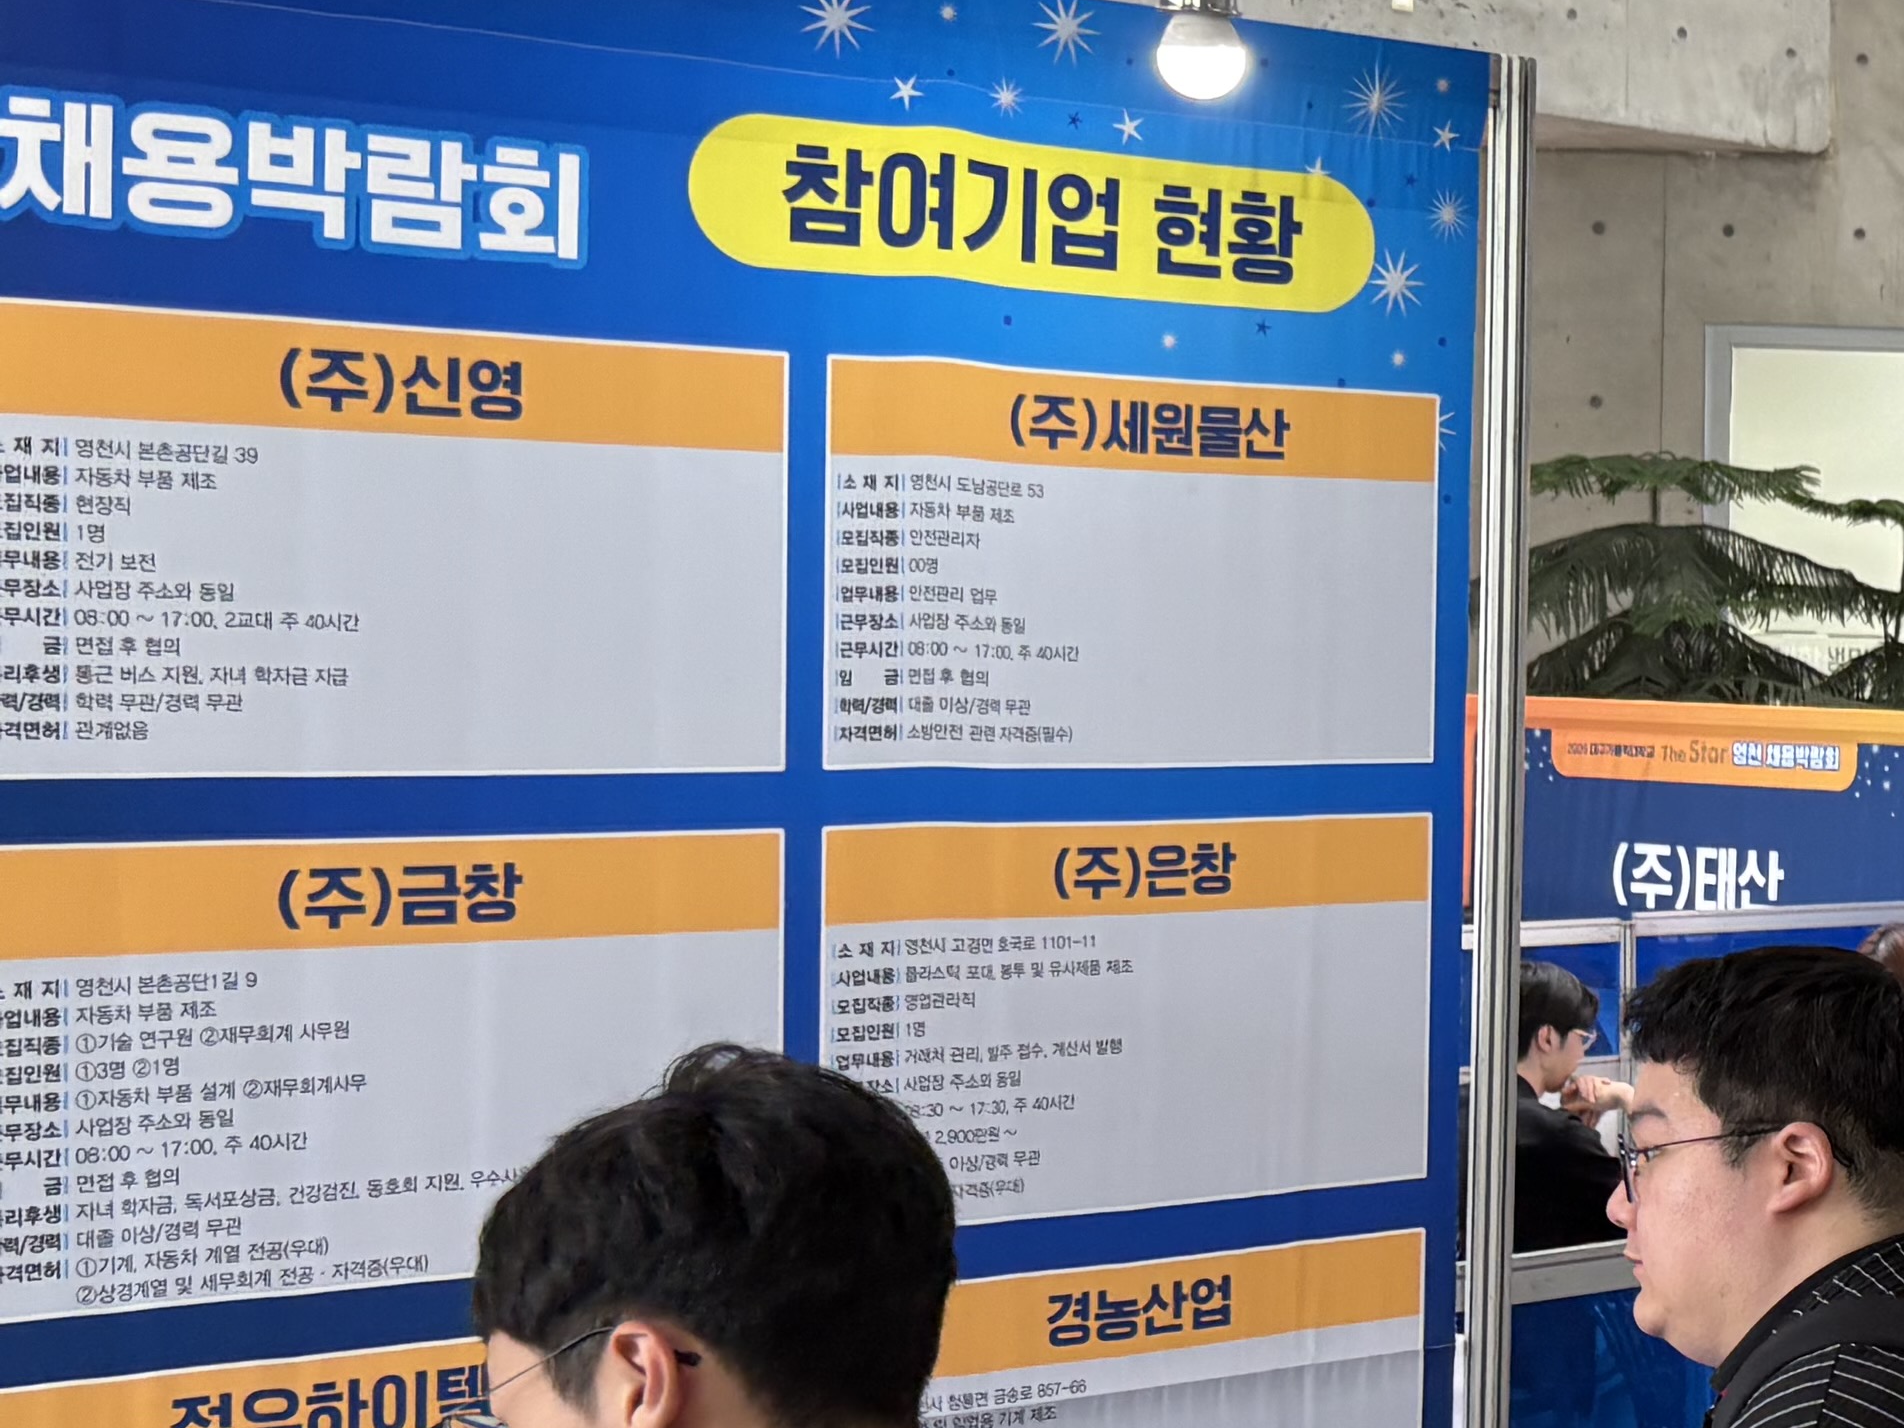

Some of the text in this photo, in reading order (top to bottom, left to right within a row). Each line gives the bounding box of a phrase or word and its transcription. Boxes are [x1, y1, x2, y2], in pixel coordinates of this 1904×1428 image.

[0, 94, 583, 262] 채용박람회
[780, 140, 1305, 288] 참여기업 현황
[277, 344, 526, 424] (주)신영
[1008, 390, 1292, 462] (주)세원물산
[75, 439, 258, 464] 영천시 본촌공단길 39
[75, 467, 217, 490] 자동차 부품 제조
[1028, 484, 1044, 498] 53
[76, 495, 130, 516] 현장직
[842, 502, 899, 519] 사업내용
[78, 524, 104, 543] 1명
[76, 551, 155, 572] 전기 보전
[74, 580, 234, 602] 사업장 주소와 동일
[74, 609, 129, 627] 08:00
[225, 611, 272, 630] 2교대
[280, 612, 299, 631] 주
[305, 613, 359, 632] 40시간
[76, 636, 180, 656] 면접 후 협의
[840, 642, 898, 658] 근무시간
[75, 720, 148, 740] 관계없음
[1053, 841, 1237, 901] (주)은창
[1612, 841, 1786, 911] (주)태산
[277, 861, 524, 930] (주)금창
[76, 972, 257, 997] 영천시 본촌공단1길 9
[140, 1028, 192, 1049] 연구원
[300, 1020, 349, 1041] 사무원
[157, 1084, 192, 1104] 부품
[200, 1081, 235, 1101] 설계
[76, 1202, 114, 1221] 자녀
[366, 1176, 417, 1198] 동호회
[145, 1247, 197, 1270] 자동차
[205, 1245, 240, 1264] 계열
[248, 1236, 328, 1261] 전공(우대)
[1045, 1273, 1233, 1348] 경농산업
